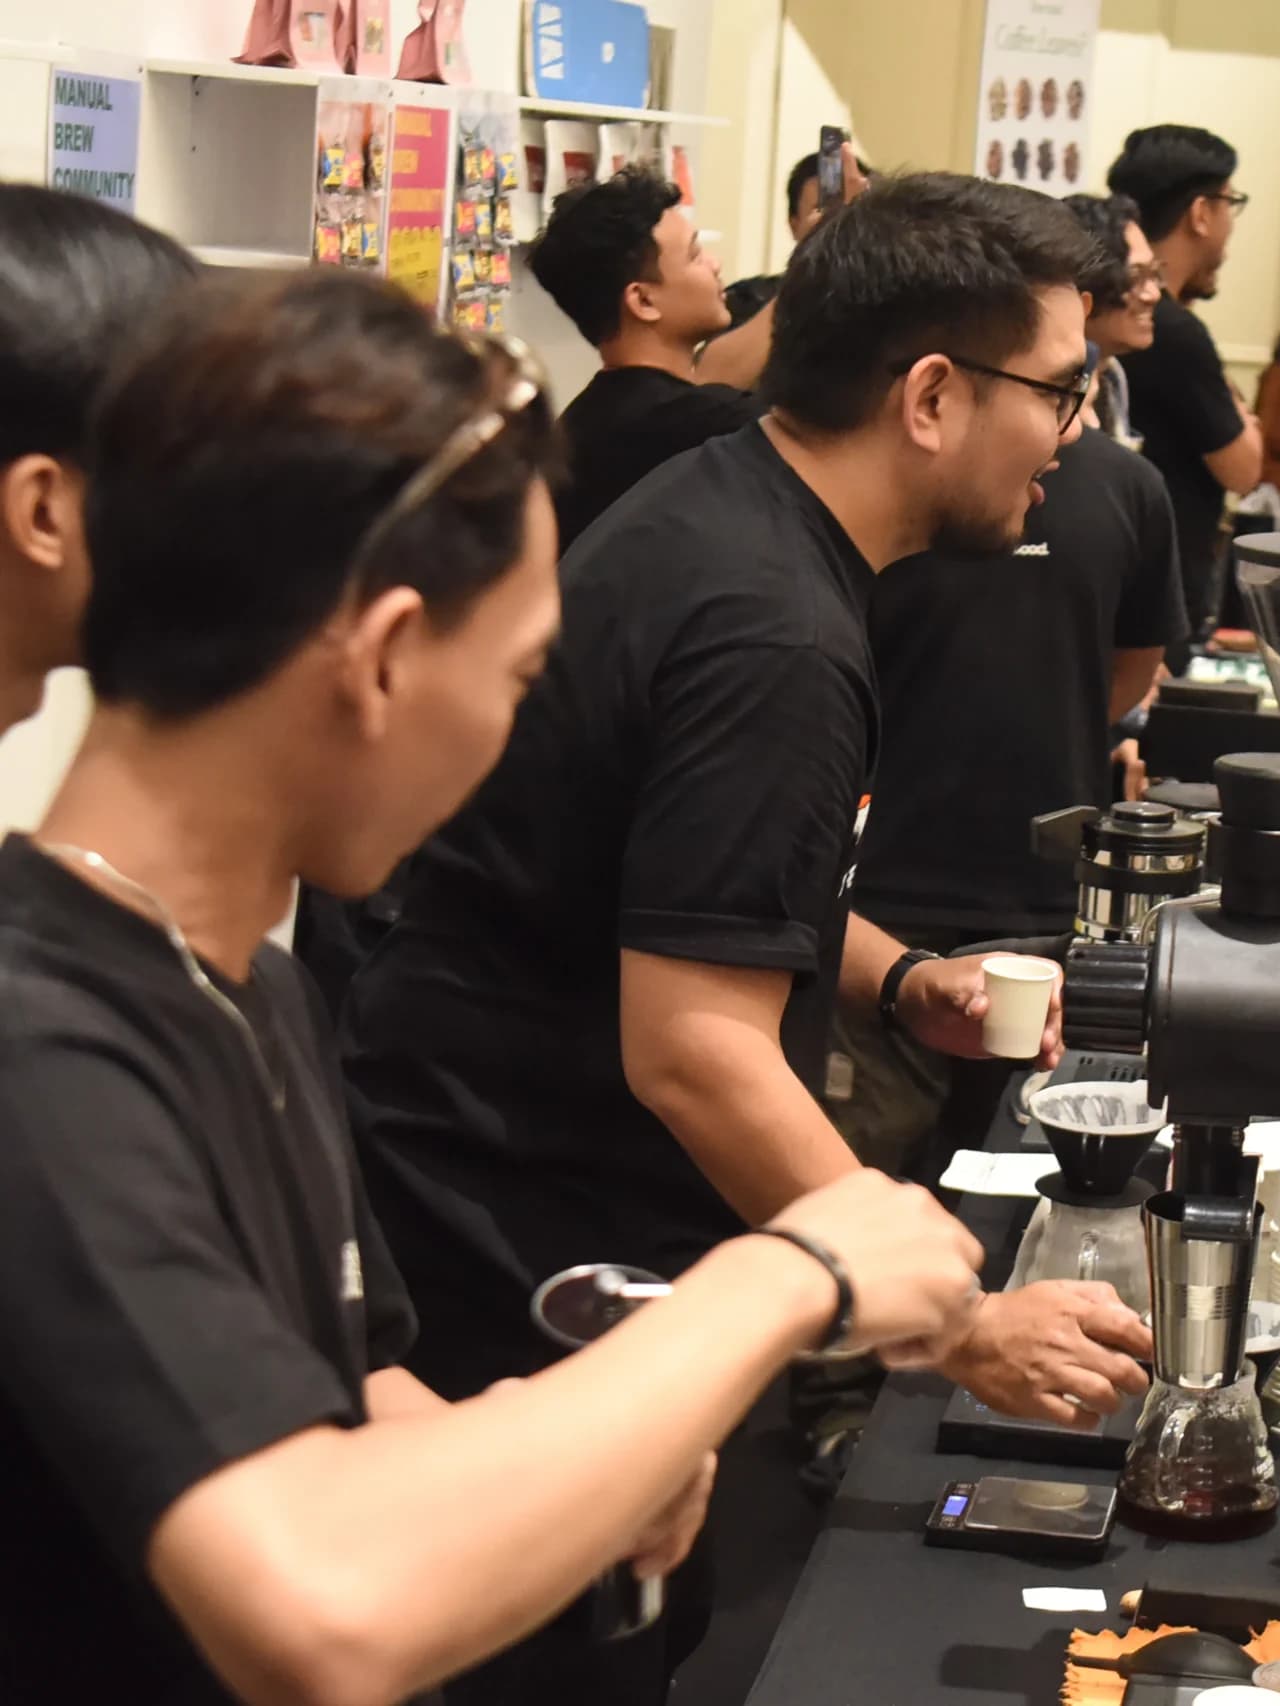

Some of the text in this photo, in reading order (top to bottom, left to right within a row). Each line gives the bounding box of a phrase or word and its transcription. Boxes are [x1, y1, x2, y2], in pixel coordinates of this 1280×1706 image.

[54, 76, 113, 111] MANUAL
[54, 122, 95, 152] BREW
[54, 167, 135, 198] COMMUNITY
